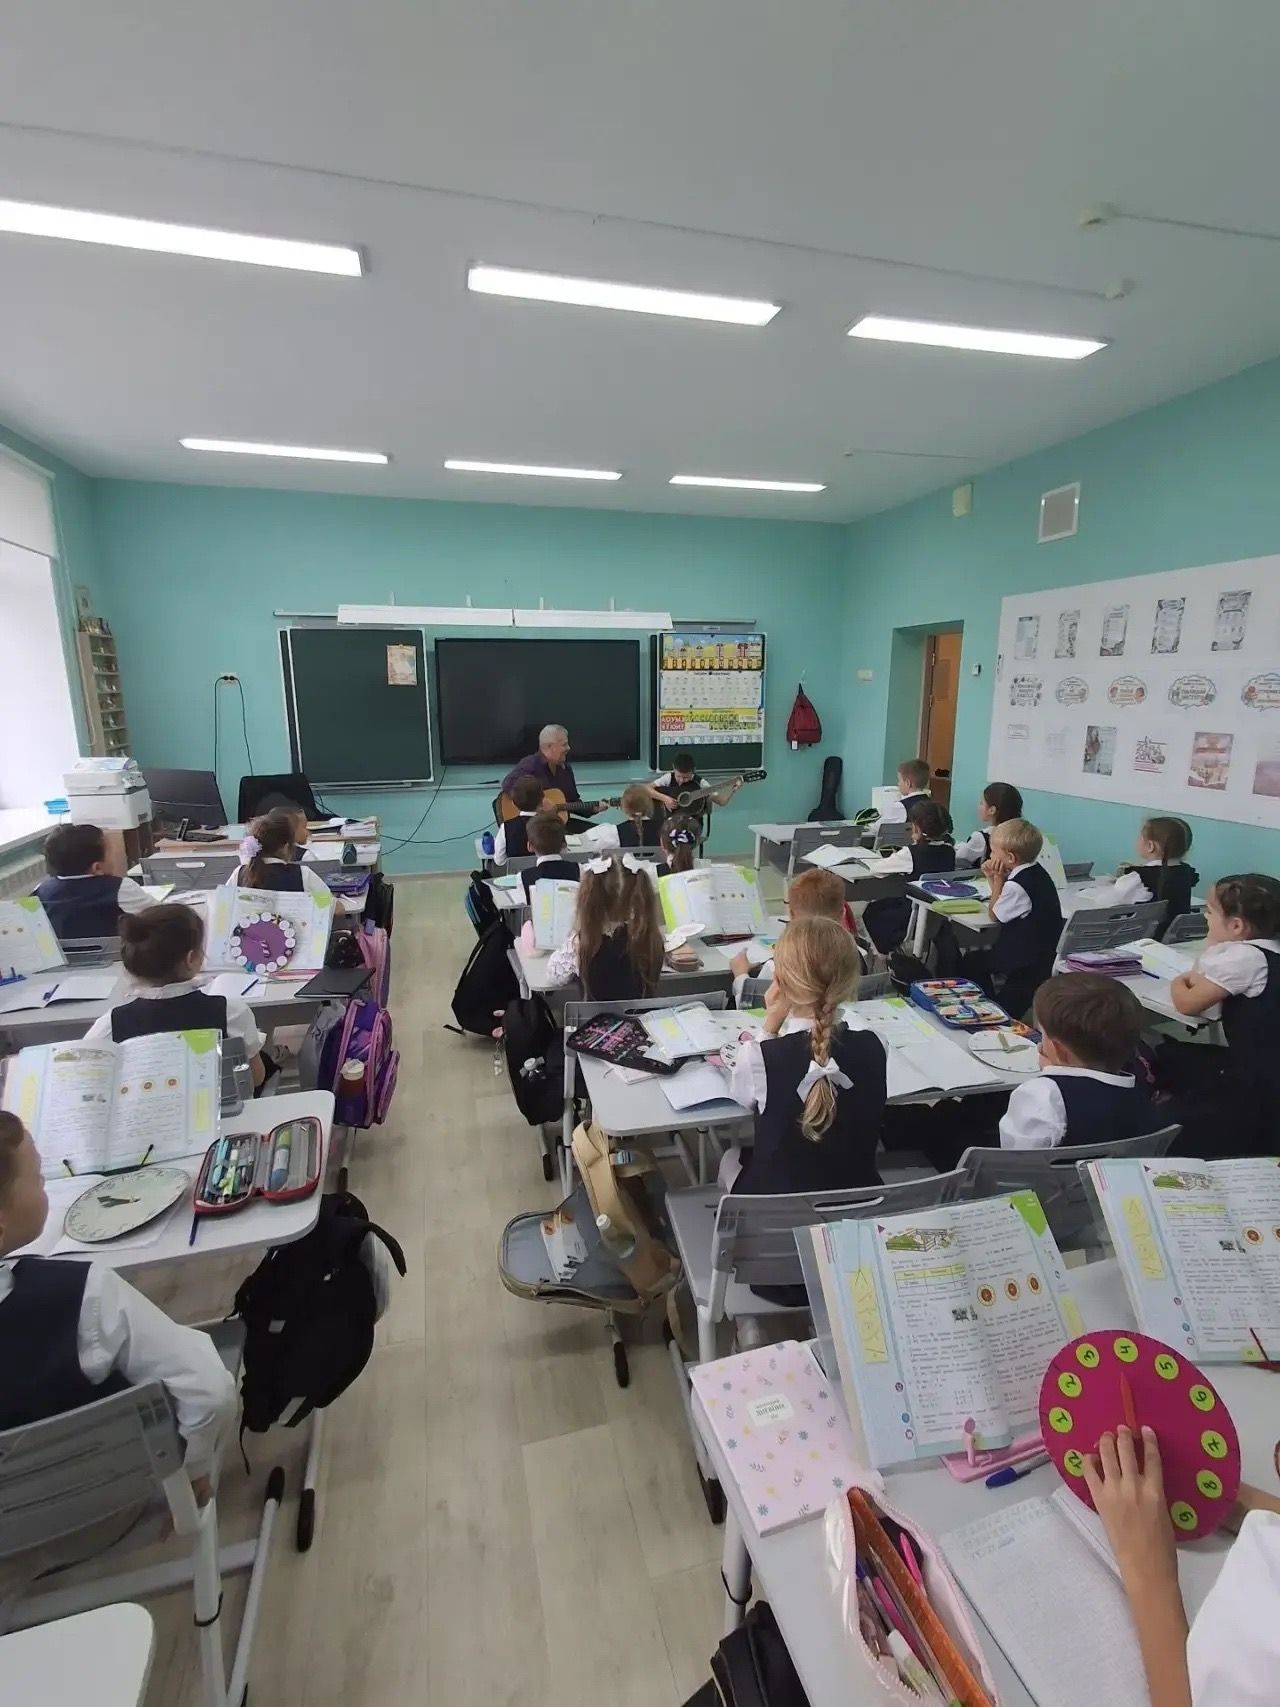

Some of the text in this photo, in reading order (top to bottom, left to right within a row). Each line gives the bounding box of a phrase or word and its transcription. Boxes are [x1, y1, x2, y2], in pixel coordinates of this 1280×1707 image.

[1120, 1345, 1131, 1354] 4
[1083, 1350, 1095, 1361] 3
[1159, 1361, 1173, 1370] 5
[1066, 1375, 1077, 1388] 2
[1197, 1390, 1207, 1402] 6
[1056, 1412, 1068, 1423] 1
[1207, 1438, 1220, 1451] 7
[1203, 1480, 1218, 1490] 8
[1179, 1511, 1194, 1522] 9
